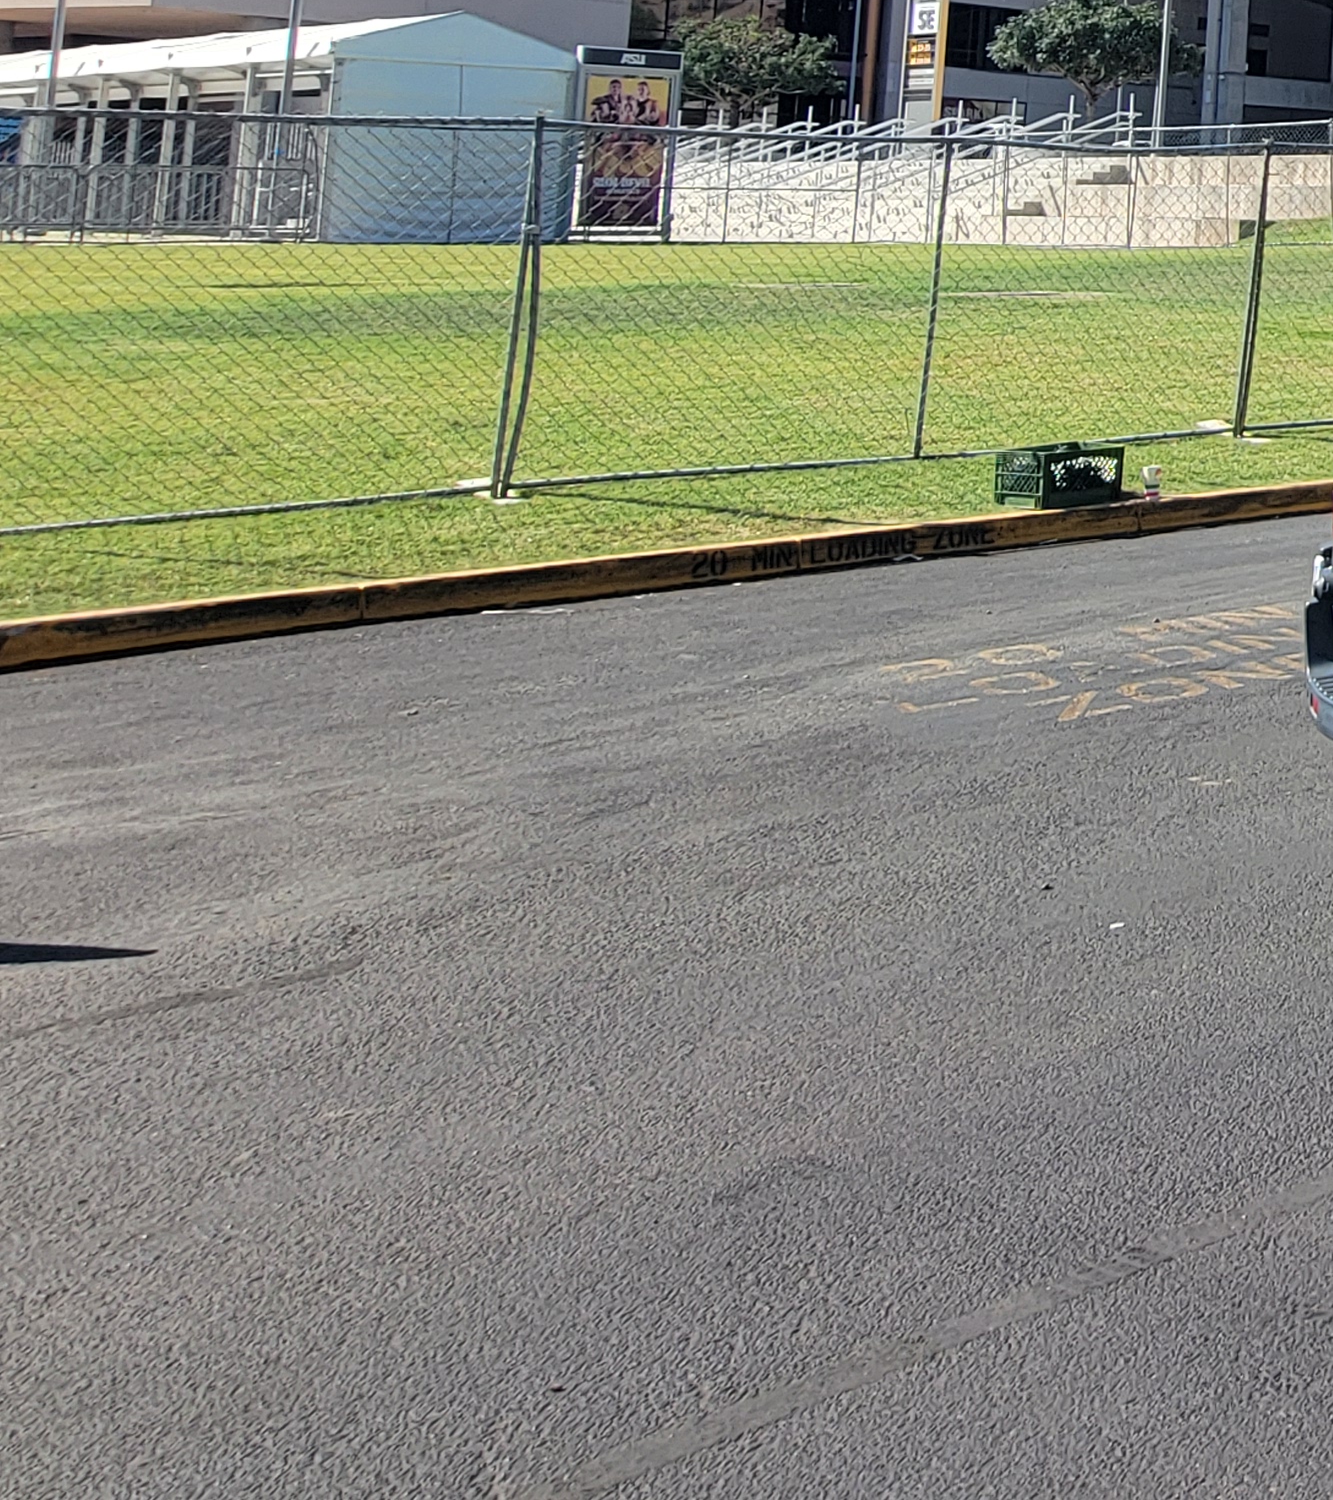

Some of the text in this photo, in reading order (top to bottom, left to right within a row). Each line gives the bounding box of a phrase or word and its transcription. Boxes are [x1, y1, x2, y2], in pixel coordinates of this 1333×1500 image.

[620, 53, 646, 66] ASU
[691, 524, 997, 579] 20 MIN LOADING ZONE
